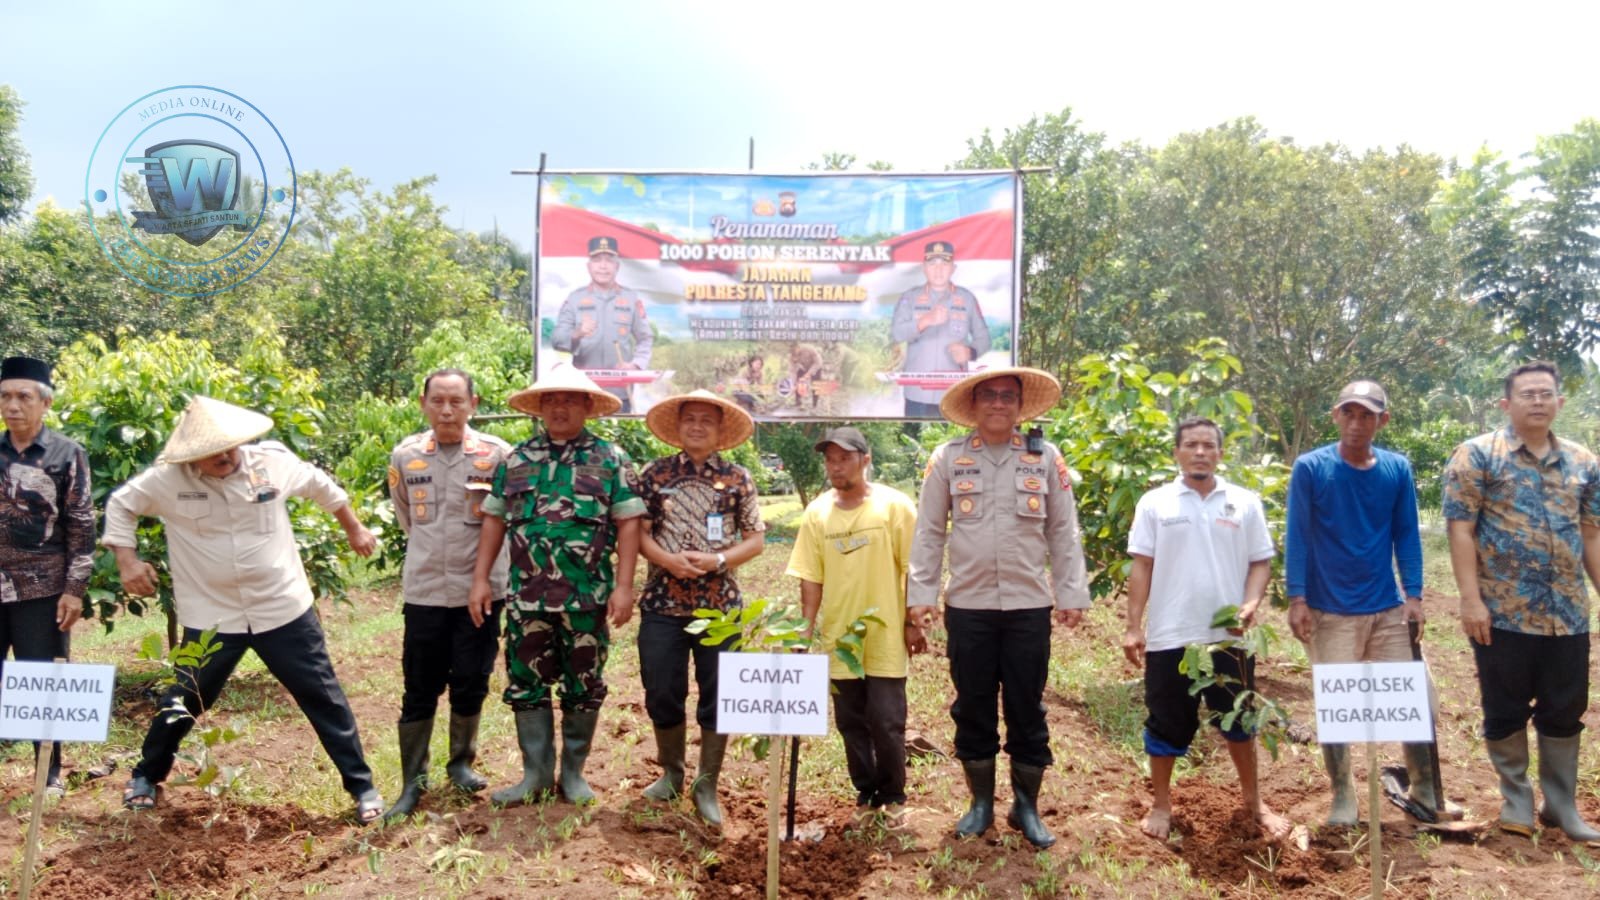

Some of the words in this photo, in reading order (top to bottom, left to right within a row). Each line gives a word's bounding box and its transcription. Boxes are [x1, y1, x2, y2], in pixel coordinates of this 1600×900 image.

[711, 215, 838, 239] Penanaman
[660, 244, 703, 261] 1000
[706, 244, 776, 262] POHON
[780, 245, 891, 262] SERENTAK
[742, 267, 812, 283] JAJARAN
[685, 284, 765, 301] POLRESTA
[771, 284, 867, 302] TANGERANG
[1015, 467, 1046, 476] POLRI
[6, 676, 103, 693] DANRAMIL
[739, 668, 803, 684] CAMAT
[1320, 676, 1415, 693] KAPOLSEK
[3, 704, 100, 722] TIGARAKSA
[721, 698, 819, 715] TIGARAKSA
[1318, 707, 1421, 723] TIGARAKSA
